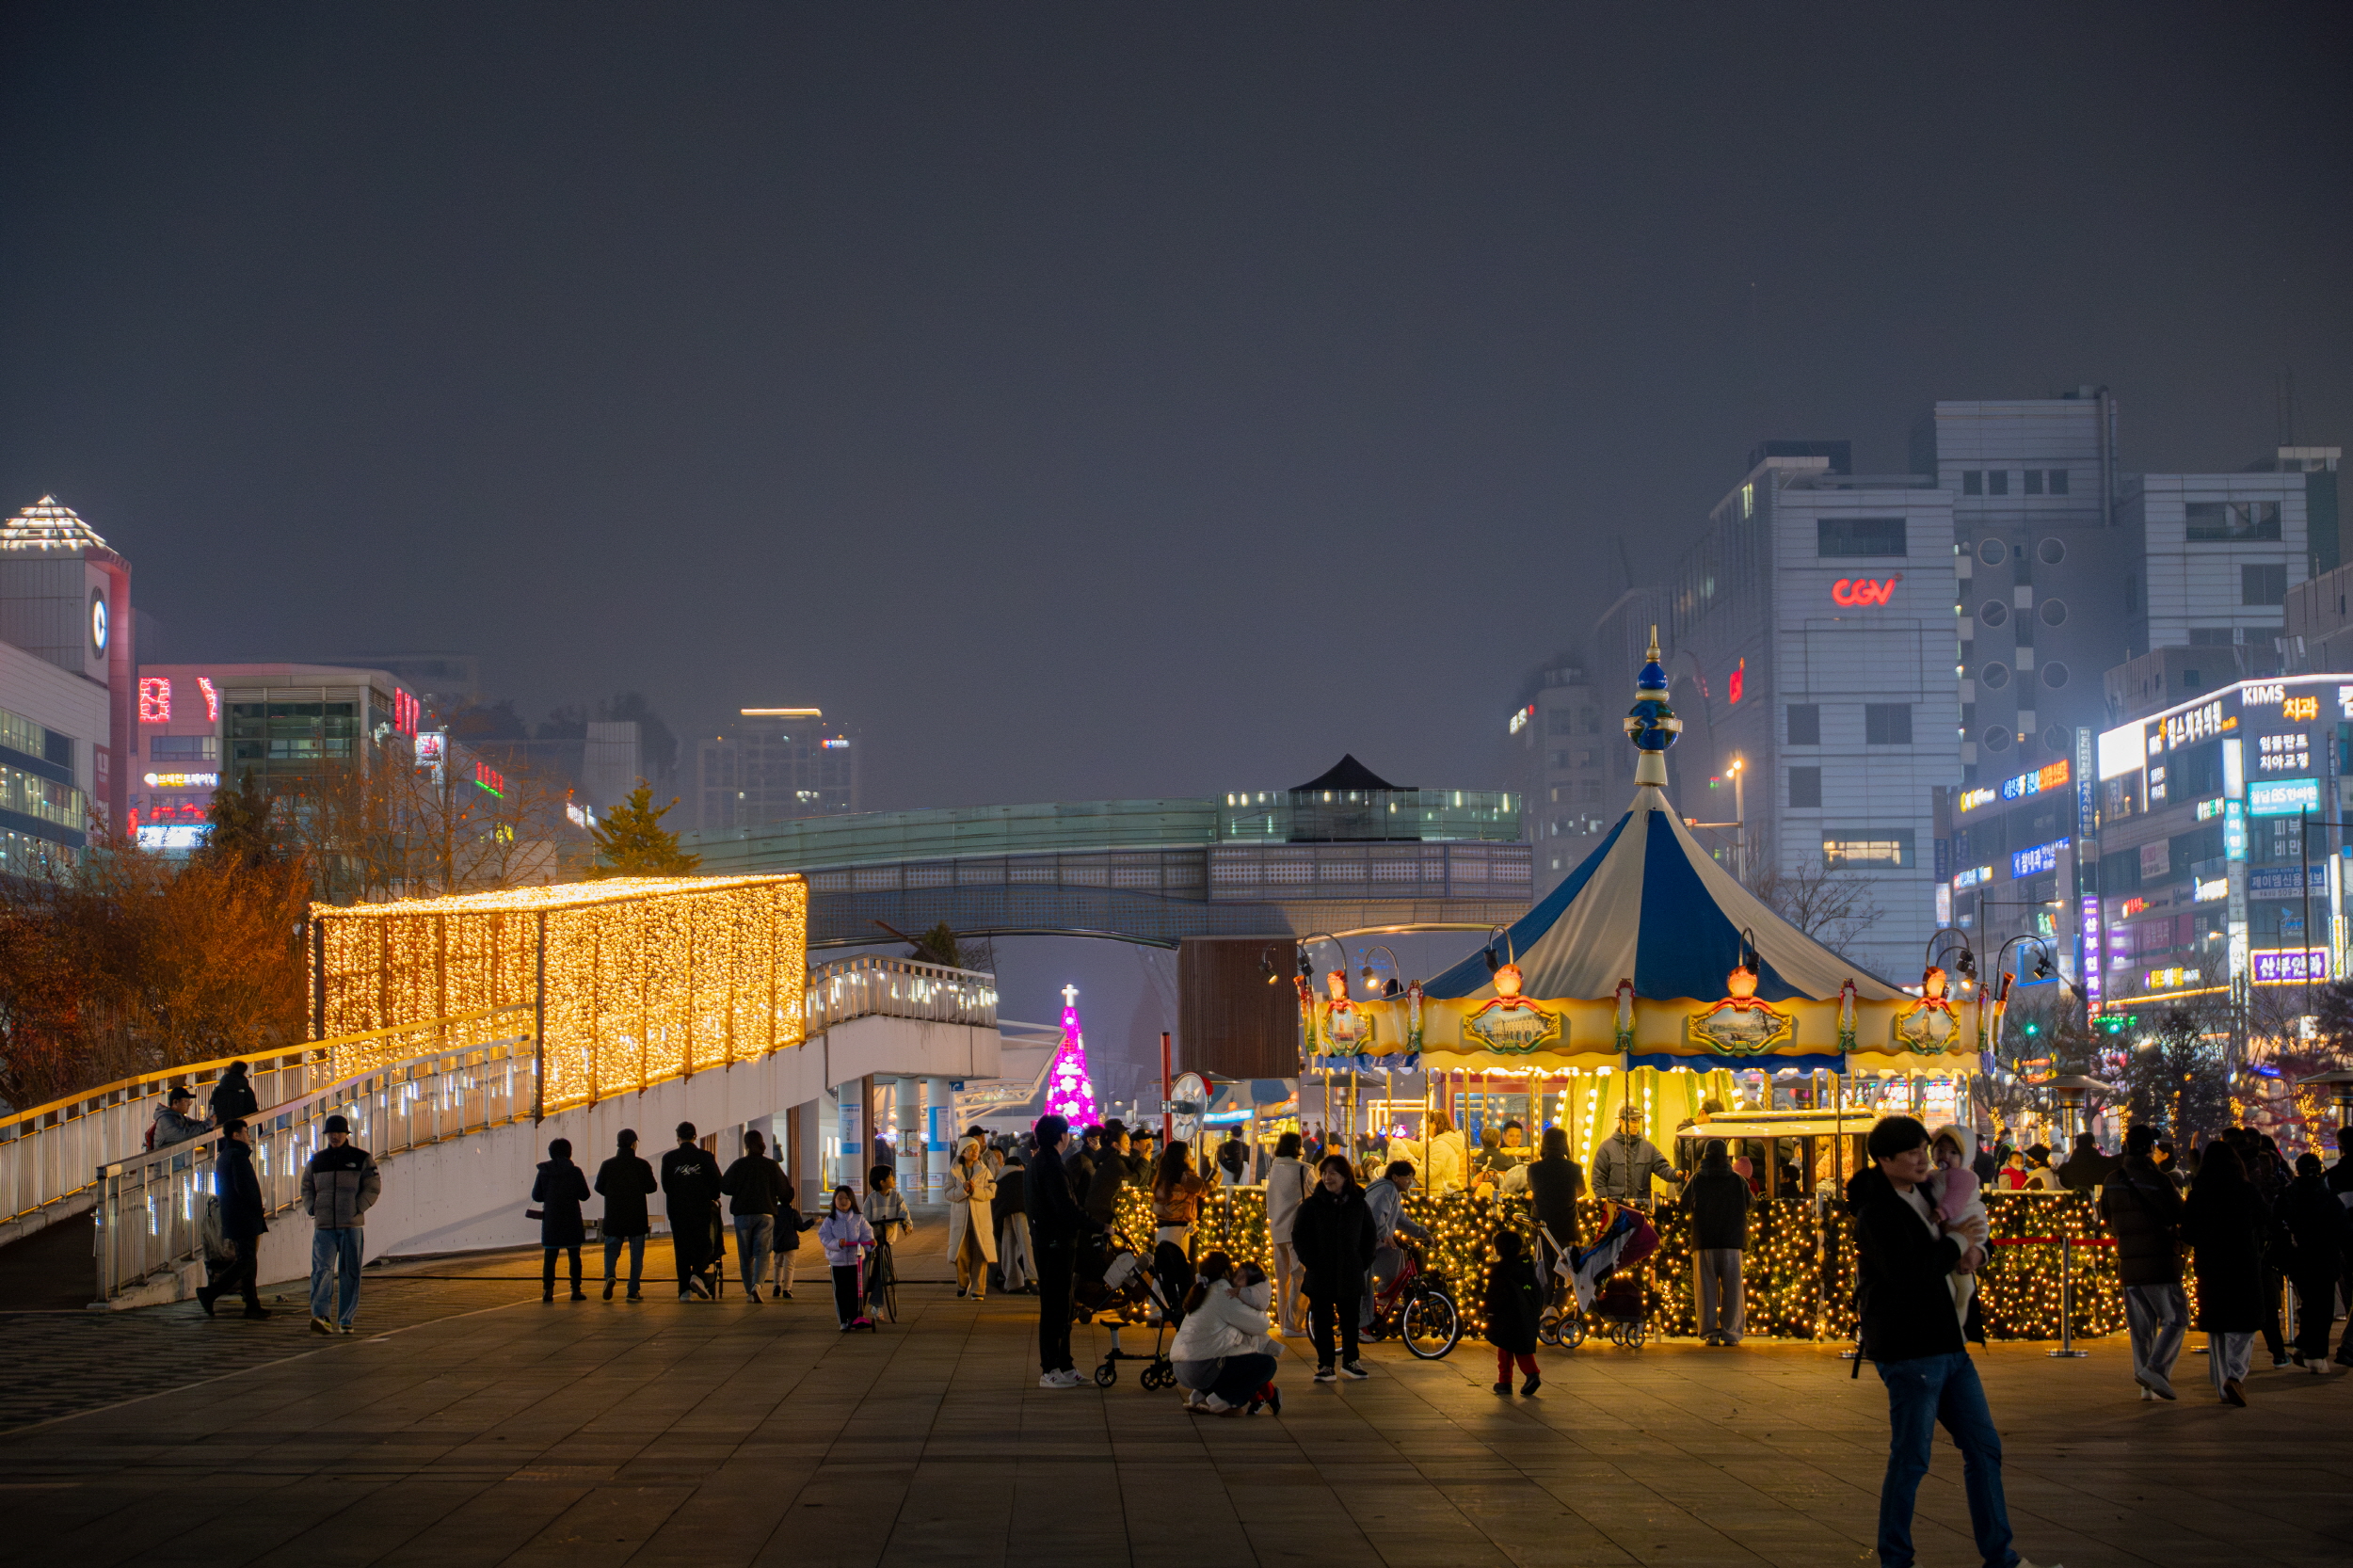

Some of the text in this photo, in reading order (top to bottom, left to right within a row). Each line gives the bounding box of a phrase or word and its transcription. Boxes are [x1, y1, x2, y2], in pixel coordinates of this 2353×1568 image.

[1832, 578, 1896, 606] CGV
[2242, 684, 2285, 706] KIMS
[2283, 696, 2319, 721] 치과
[2167, 700, 2222, 750] 킴스치과의원
[2259, 733, 2309, 753] 임플란트
[2260, 752, 2309, 771] 치아교정
[157, 773, 219, 787] 브레인트레이닝
[2227, 802, 2241, 848] 한의원
[2274, 819, 2301, 836] 피부
[2274, 839, 2301, 856] 비만
[2084, 917, 2100, 990] 산부인과
[2260, 953, 2322, 979] 산부인과
